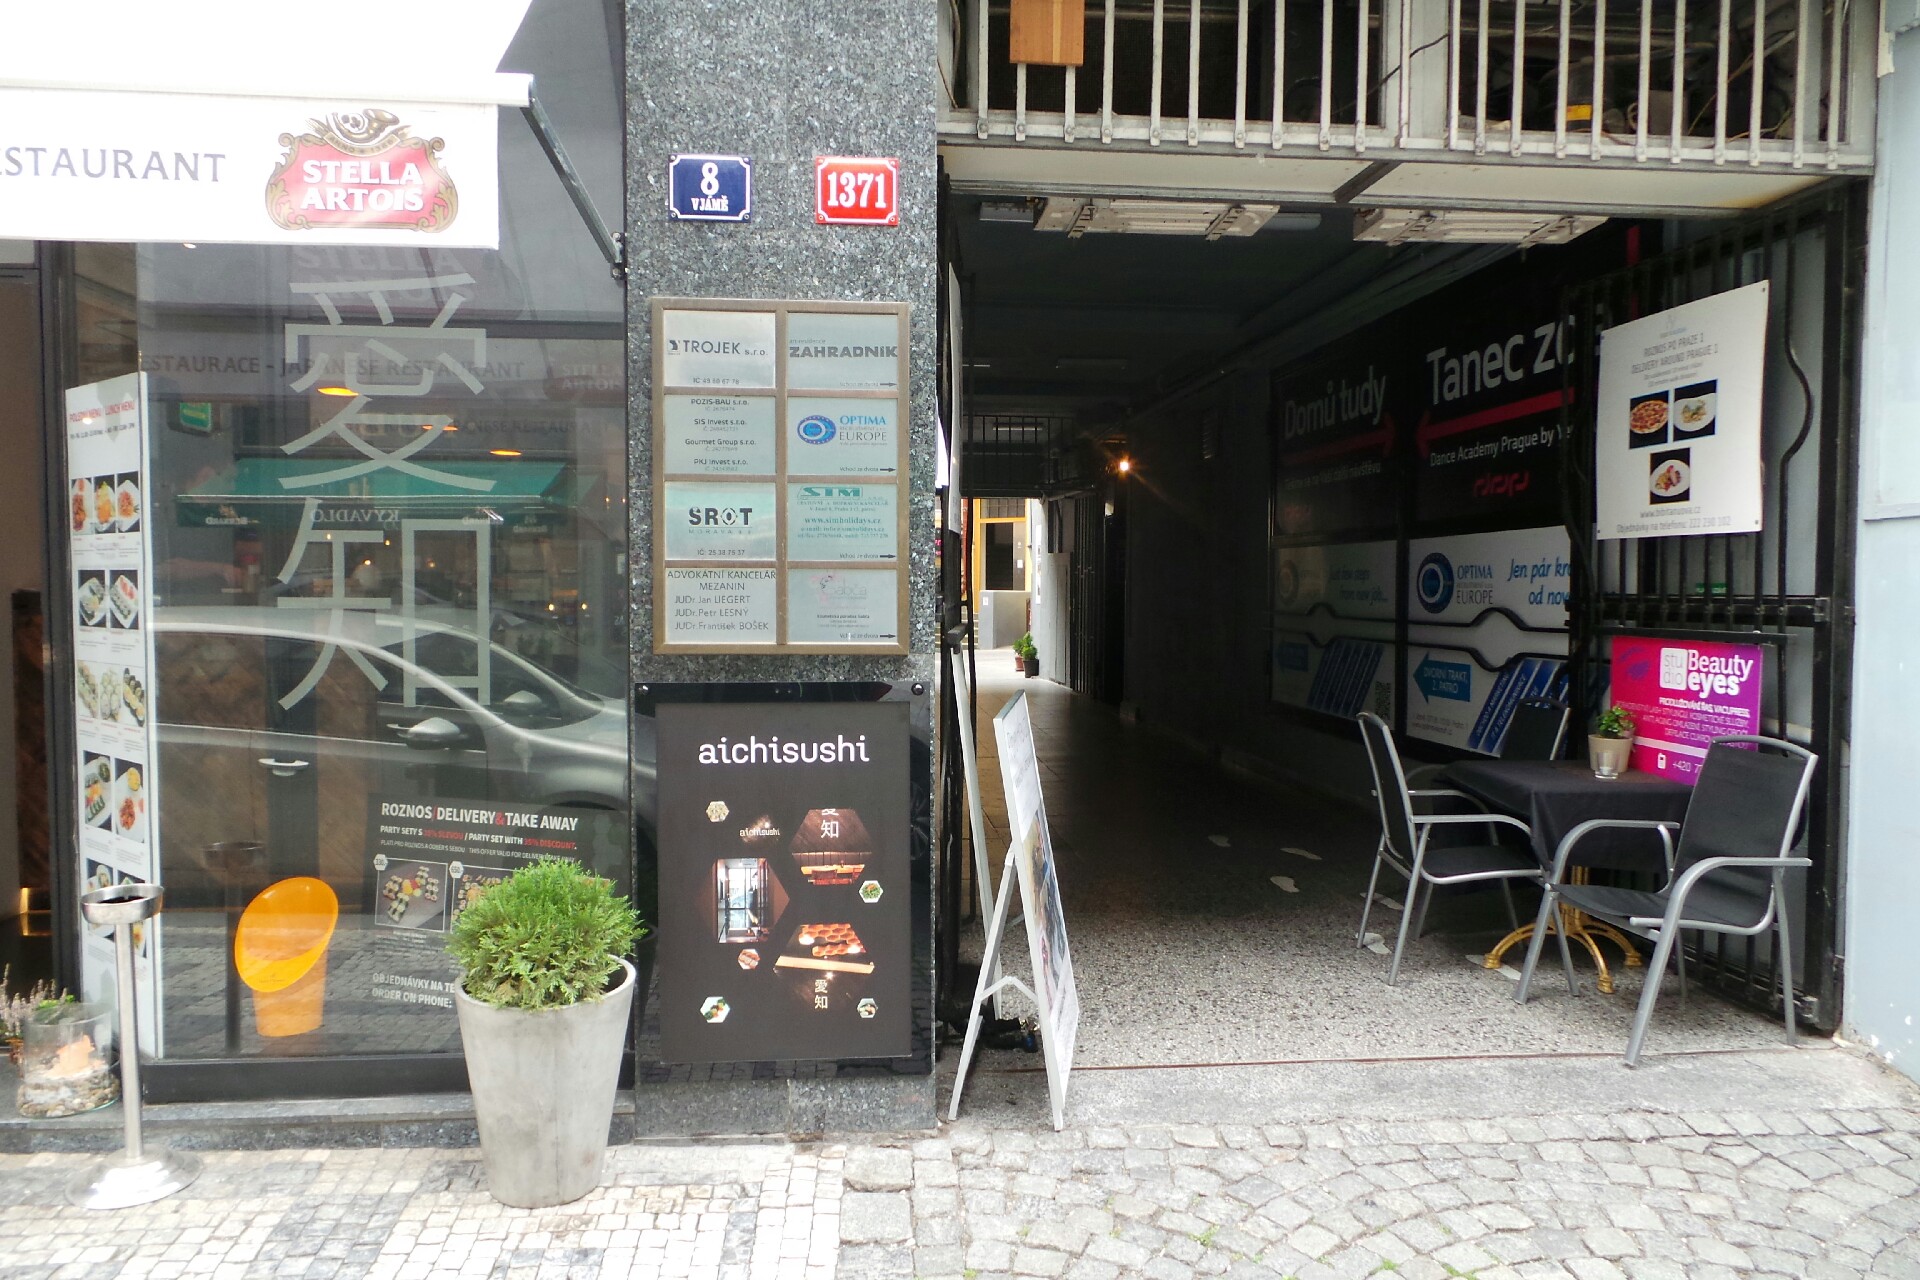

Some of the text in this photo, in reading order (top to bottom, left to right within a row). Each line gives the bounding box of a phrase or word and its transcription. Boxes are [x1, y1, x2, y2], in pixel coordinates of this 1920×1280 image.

[0, 146, 226, 182] STAURANT
[302, 159, 424, 185] STELLA
[700, 161, 720, 195] 8
[299, 187, 424, 212] ARTOIS
[826, 172, 886, 209] 1371
[683, 339, 769, 356] TROJEK s.r.o.
[1426, 333, 1526, 406] Tanec
[1283, 364, 1386, 440] Domů tudy
[694, 418, 706, 426] SIS
[707, 418, 729, 426] Invest
[839, 415, 887, 426] OPTIMA
[685, 438, 716, 446] Gourmet
[717, 438, 738, 447] Group
[839, 431, 888, 441] EUROPE
[1429, 448, 1456, 467] Dance
[1457, 440, 1499, 459] Academy
[1500, 432, 1538, 456] Prague
[1540, 426, 1555, 450] by
[804, 517, 882, 526] www.simholidays.cz
[1456, 565, 1493, 580] OPTIMA
[1507, 557, 1528, 582] Jen
[1530, 556, 1552, 583] pár
[699, 582, 746, 591] MEZANIN
[1528, 585, 1544, 606] od
[714, 595, 751, 604] LIEGERT
[1456, 589, 1494, 605] EUROPE
[739, 620, 769, 631] BOŠEK
[1687, 649, 1754, 682] Beauty
[1687, 671, 1741, 699] eyes
[698, 734, 870, 765] aichisushi
[540, 813, 579, 832] AWAY
[739, 826, 781, 837] aichisushi
[380, 825, 400, 834] PARTY
[469, 833, 490, 842] PARTY
[490, 834, 504, 843] SET
[504, 836, 524, 845] WITH
[372, 972, 430, 989] OBJEDNÁVKY
[430, 980, 443, 991] NA
[371, 987, 453, 1009] ORDER ON PHONE:
